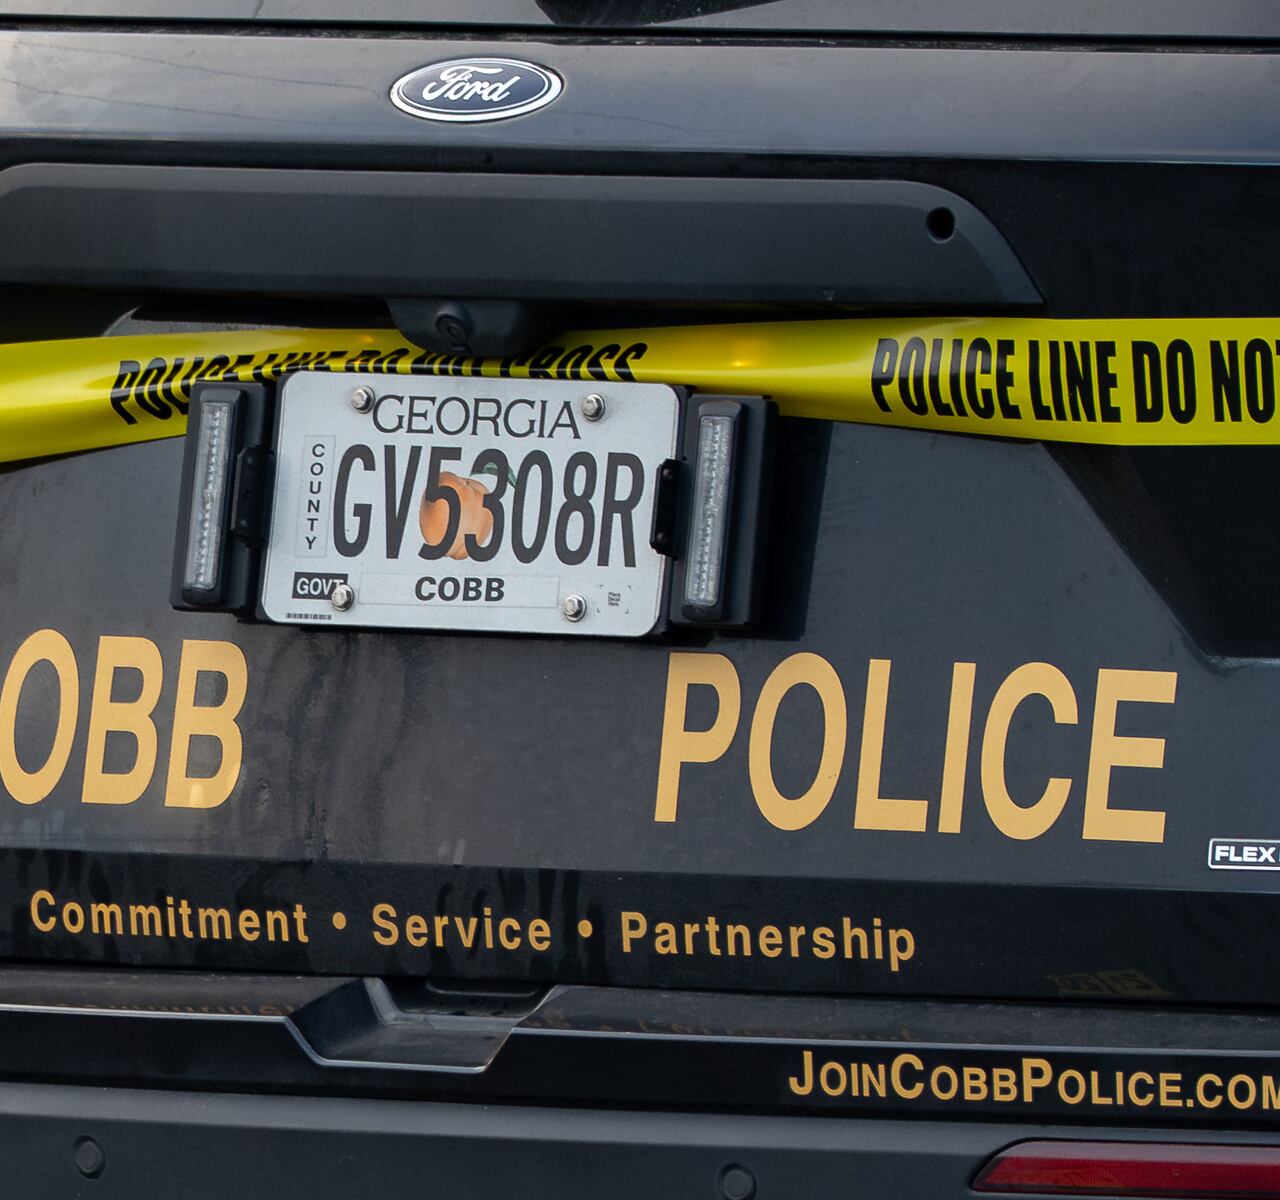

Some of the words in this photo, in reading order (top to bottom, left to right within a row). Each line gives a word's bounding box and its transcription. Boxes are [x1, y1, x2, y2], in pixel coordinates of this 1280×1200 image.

[422, 65, 521, 102] Ford
[372, 394, 582, 440] GEORGIA
[870, 337, 1023, 421] POLICE
[1028, 340, 1122, 423] LINE
[1131, 338, 1197, 424] DO
[305, 443, 326, 550] COUNTY
[333, 443, 645, 568] GV5308R
[414, 576, 505, 602] COBB
[654, 652, 1178, 844] POLICE
[1214, 845, 1276, 863] FLEX
[30, 889, 309, 943] Commitment
[372, 903, 551, 951] Service
[621, 911, 915, 972] Partnership
